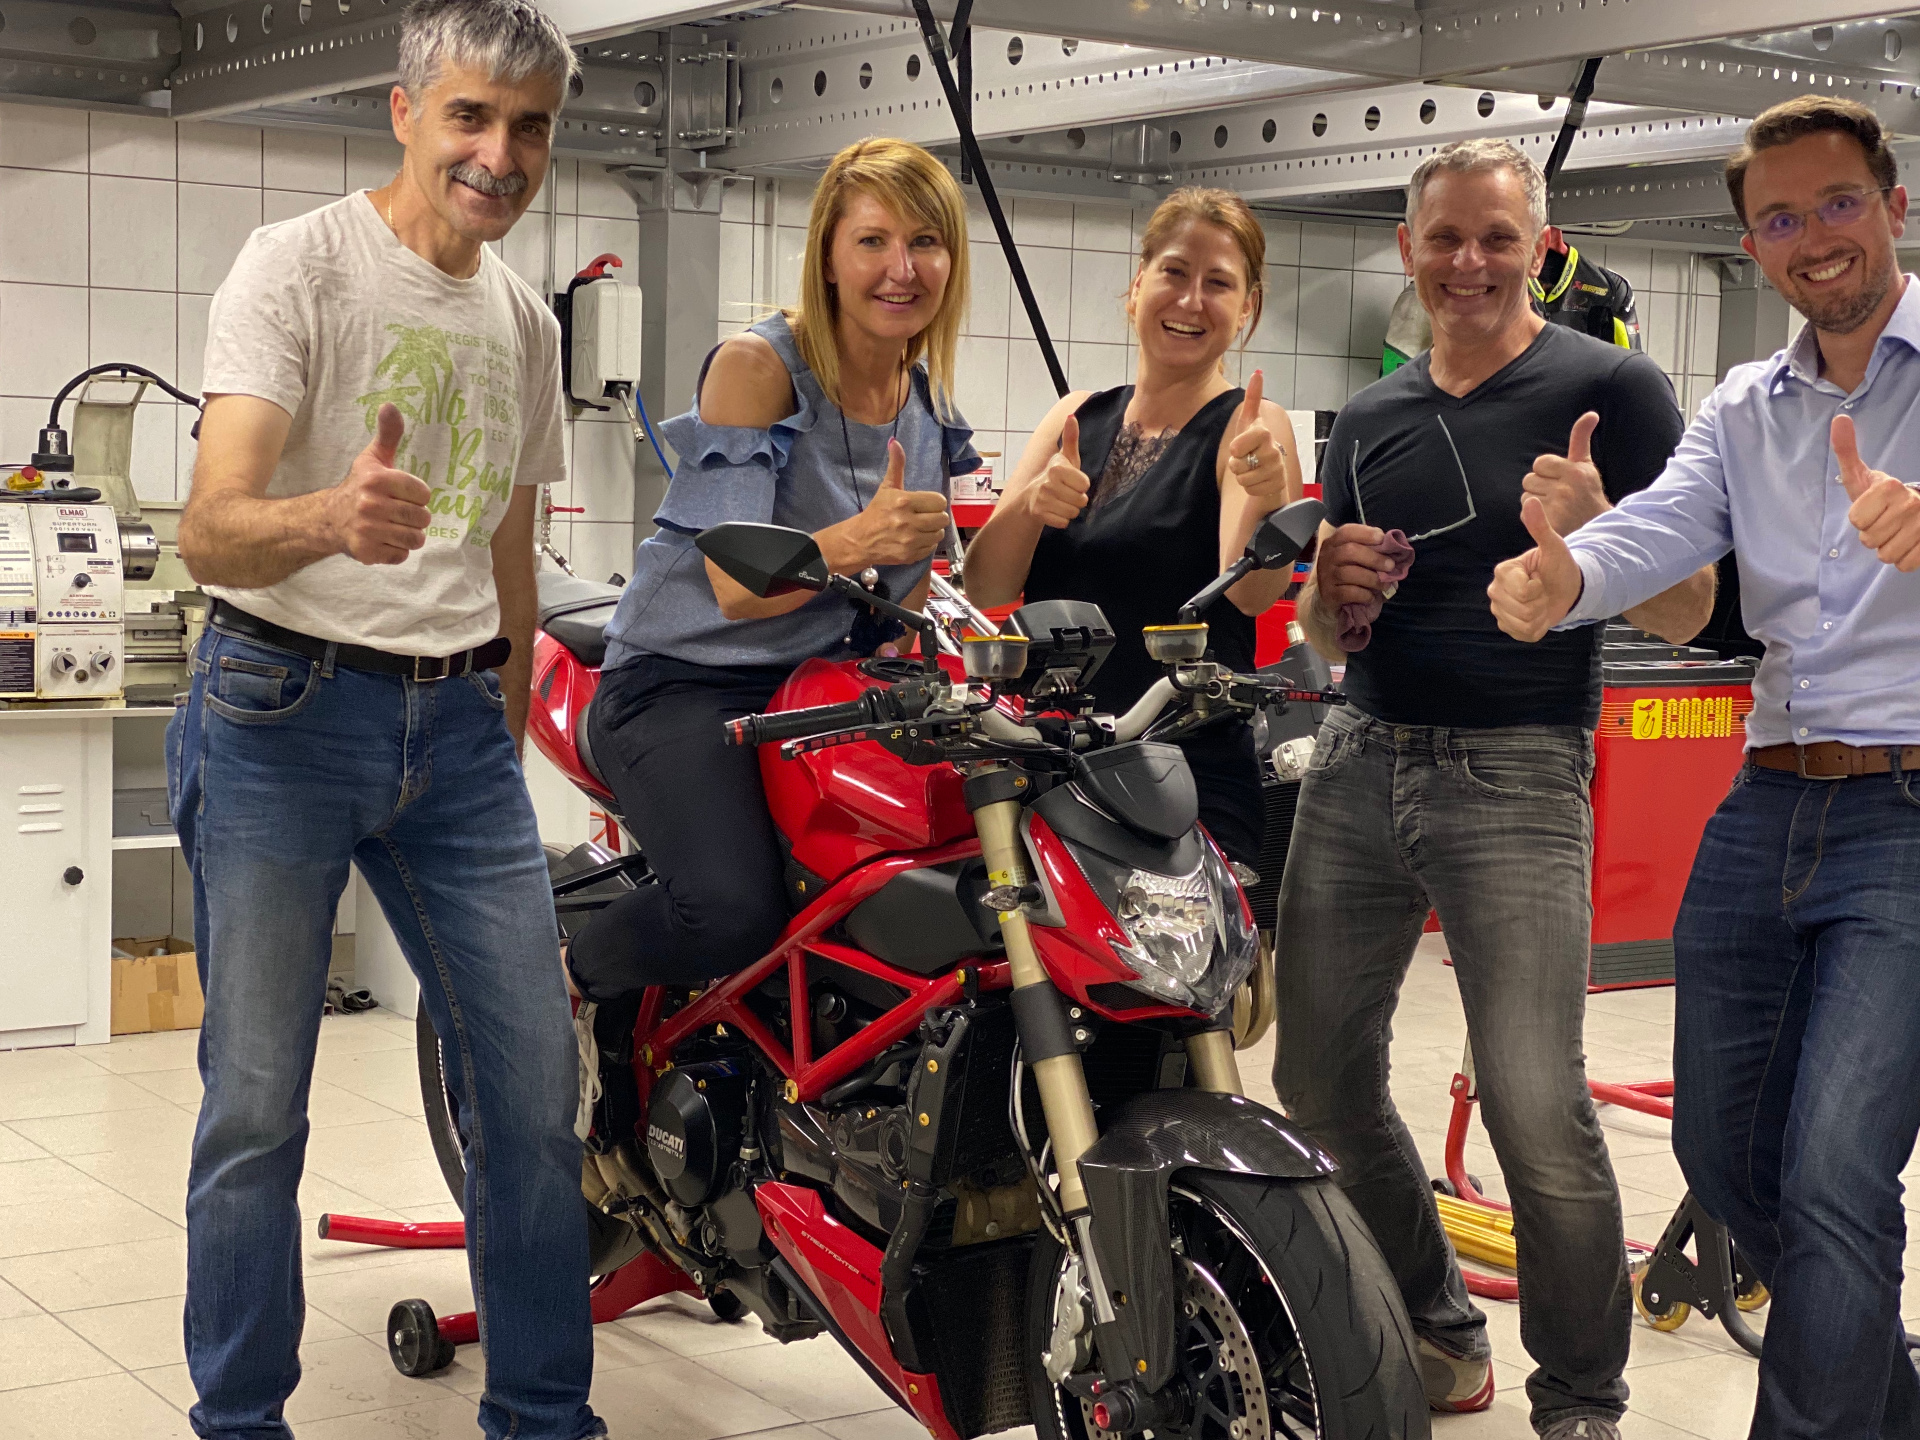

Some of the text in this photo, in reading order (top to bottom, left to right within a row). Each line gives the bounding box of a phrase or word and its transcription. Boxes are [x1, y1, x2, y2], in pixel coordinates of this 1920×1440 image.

[59, 509, 85, 517] ELMAG
[648, 1123, 684, 1153] DUCATI
[801, 1230, 860, 1275] STREETFIGHTER
